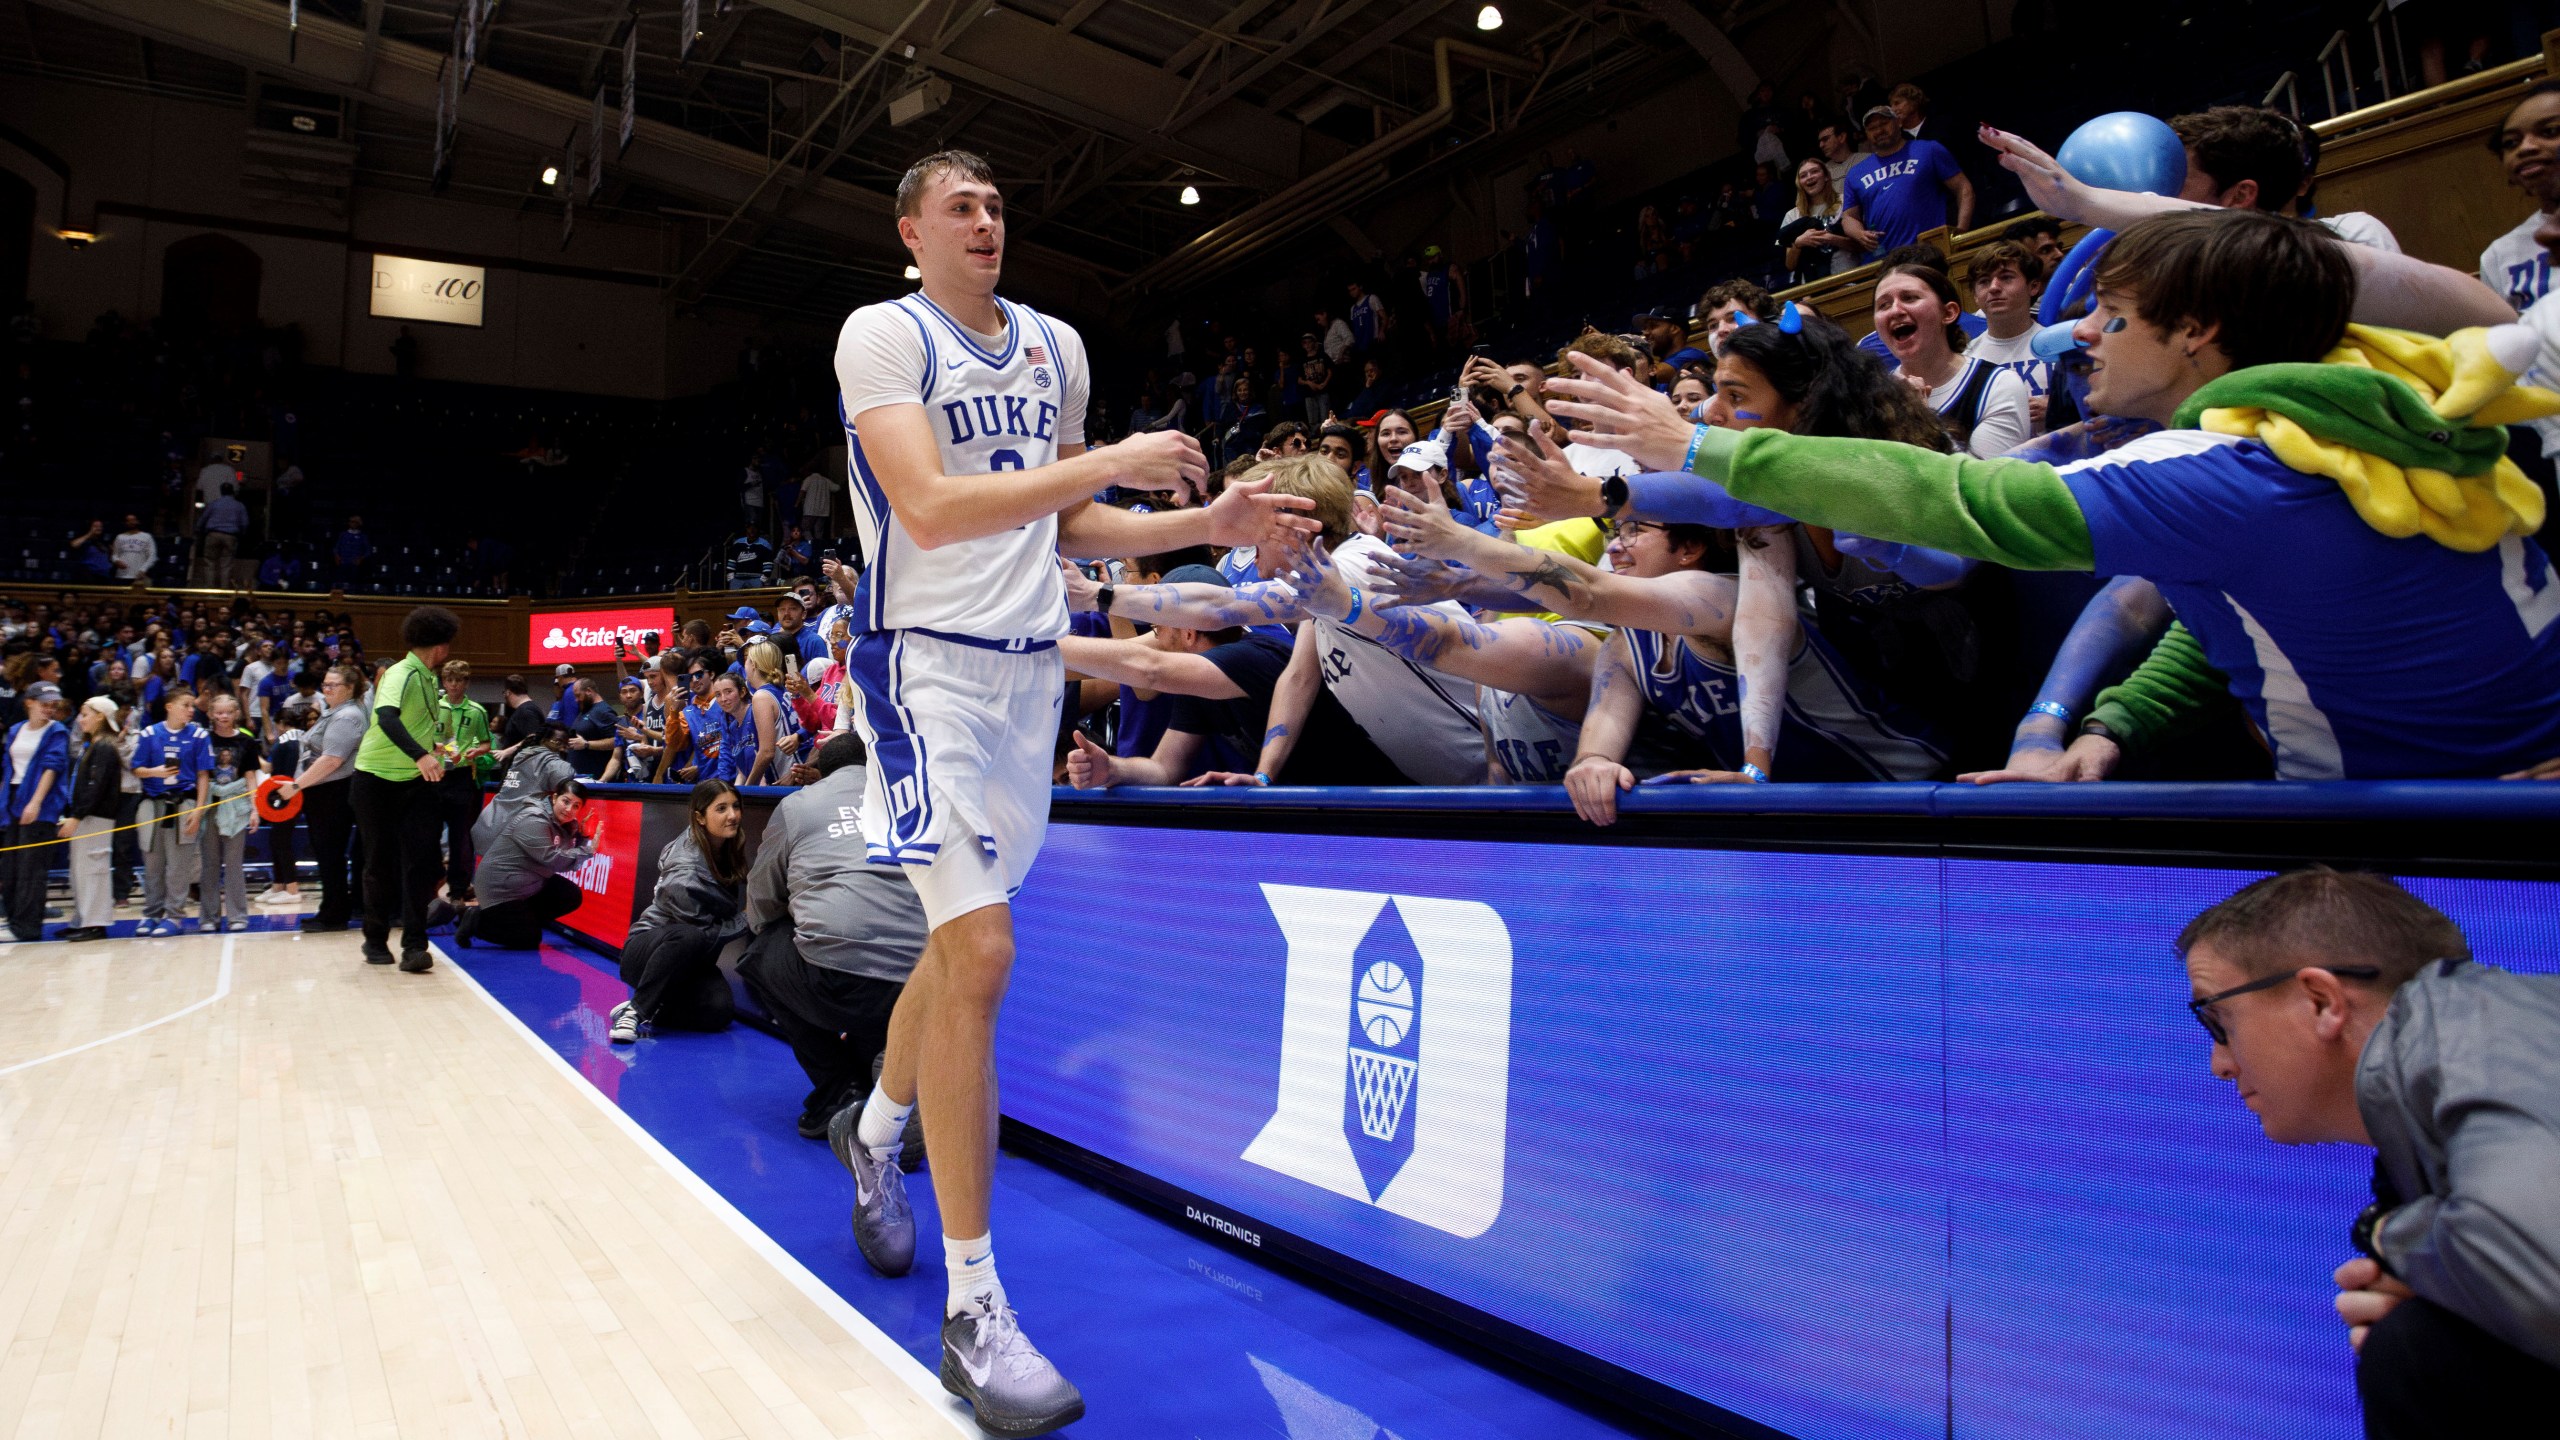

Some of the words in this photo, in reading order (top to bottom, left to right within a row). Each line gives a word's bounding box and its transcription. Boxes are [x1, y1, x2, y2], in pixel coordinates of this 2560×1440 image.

[1860, 159, 1919, 189] DUKE
[374, 271, 432, 294] De
[435, 278, 481, 299] 100
[942, 395, 1057, 445] DUKE
[570, 627, 616, 647] State
[890, 775, 917, 820] D
[1239, 882, 1514, 1239] D
[1186, 1205, 1261, 1247] DAKTRONICS
